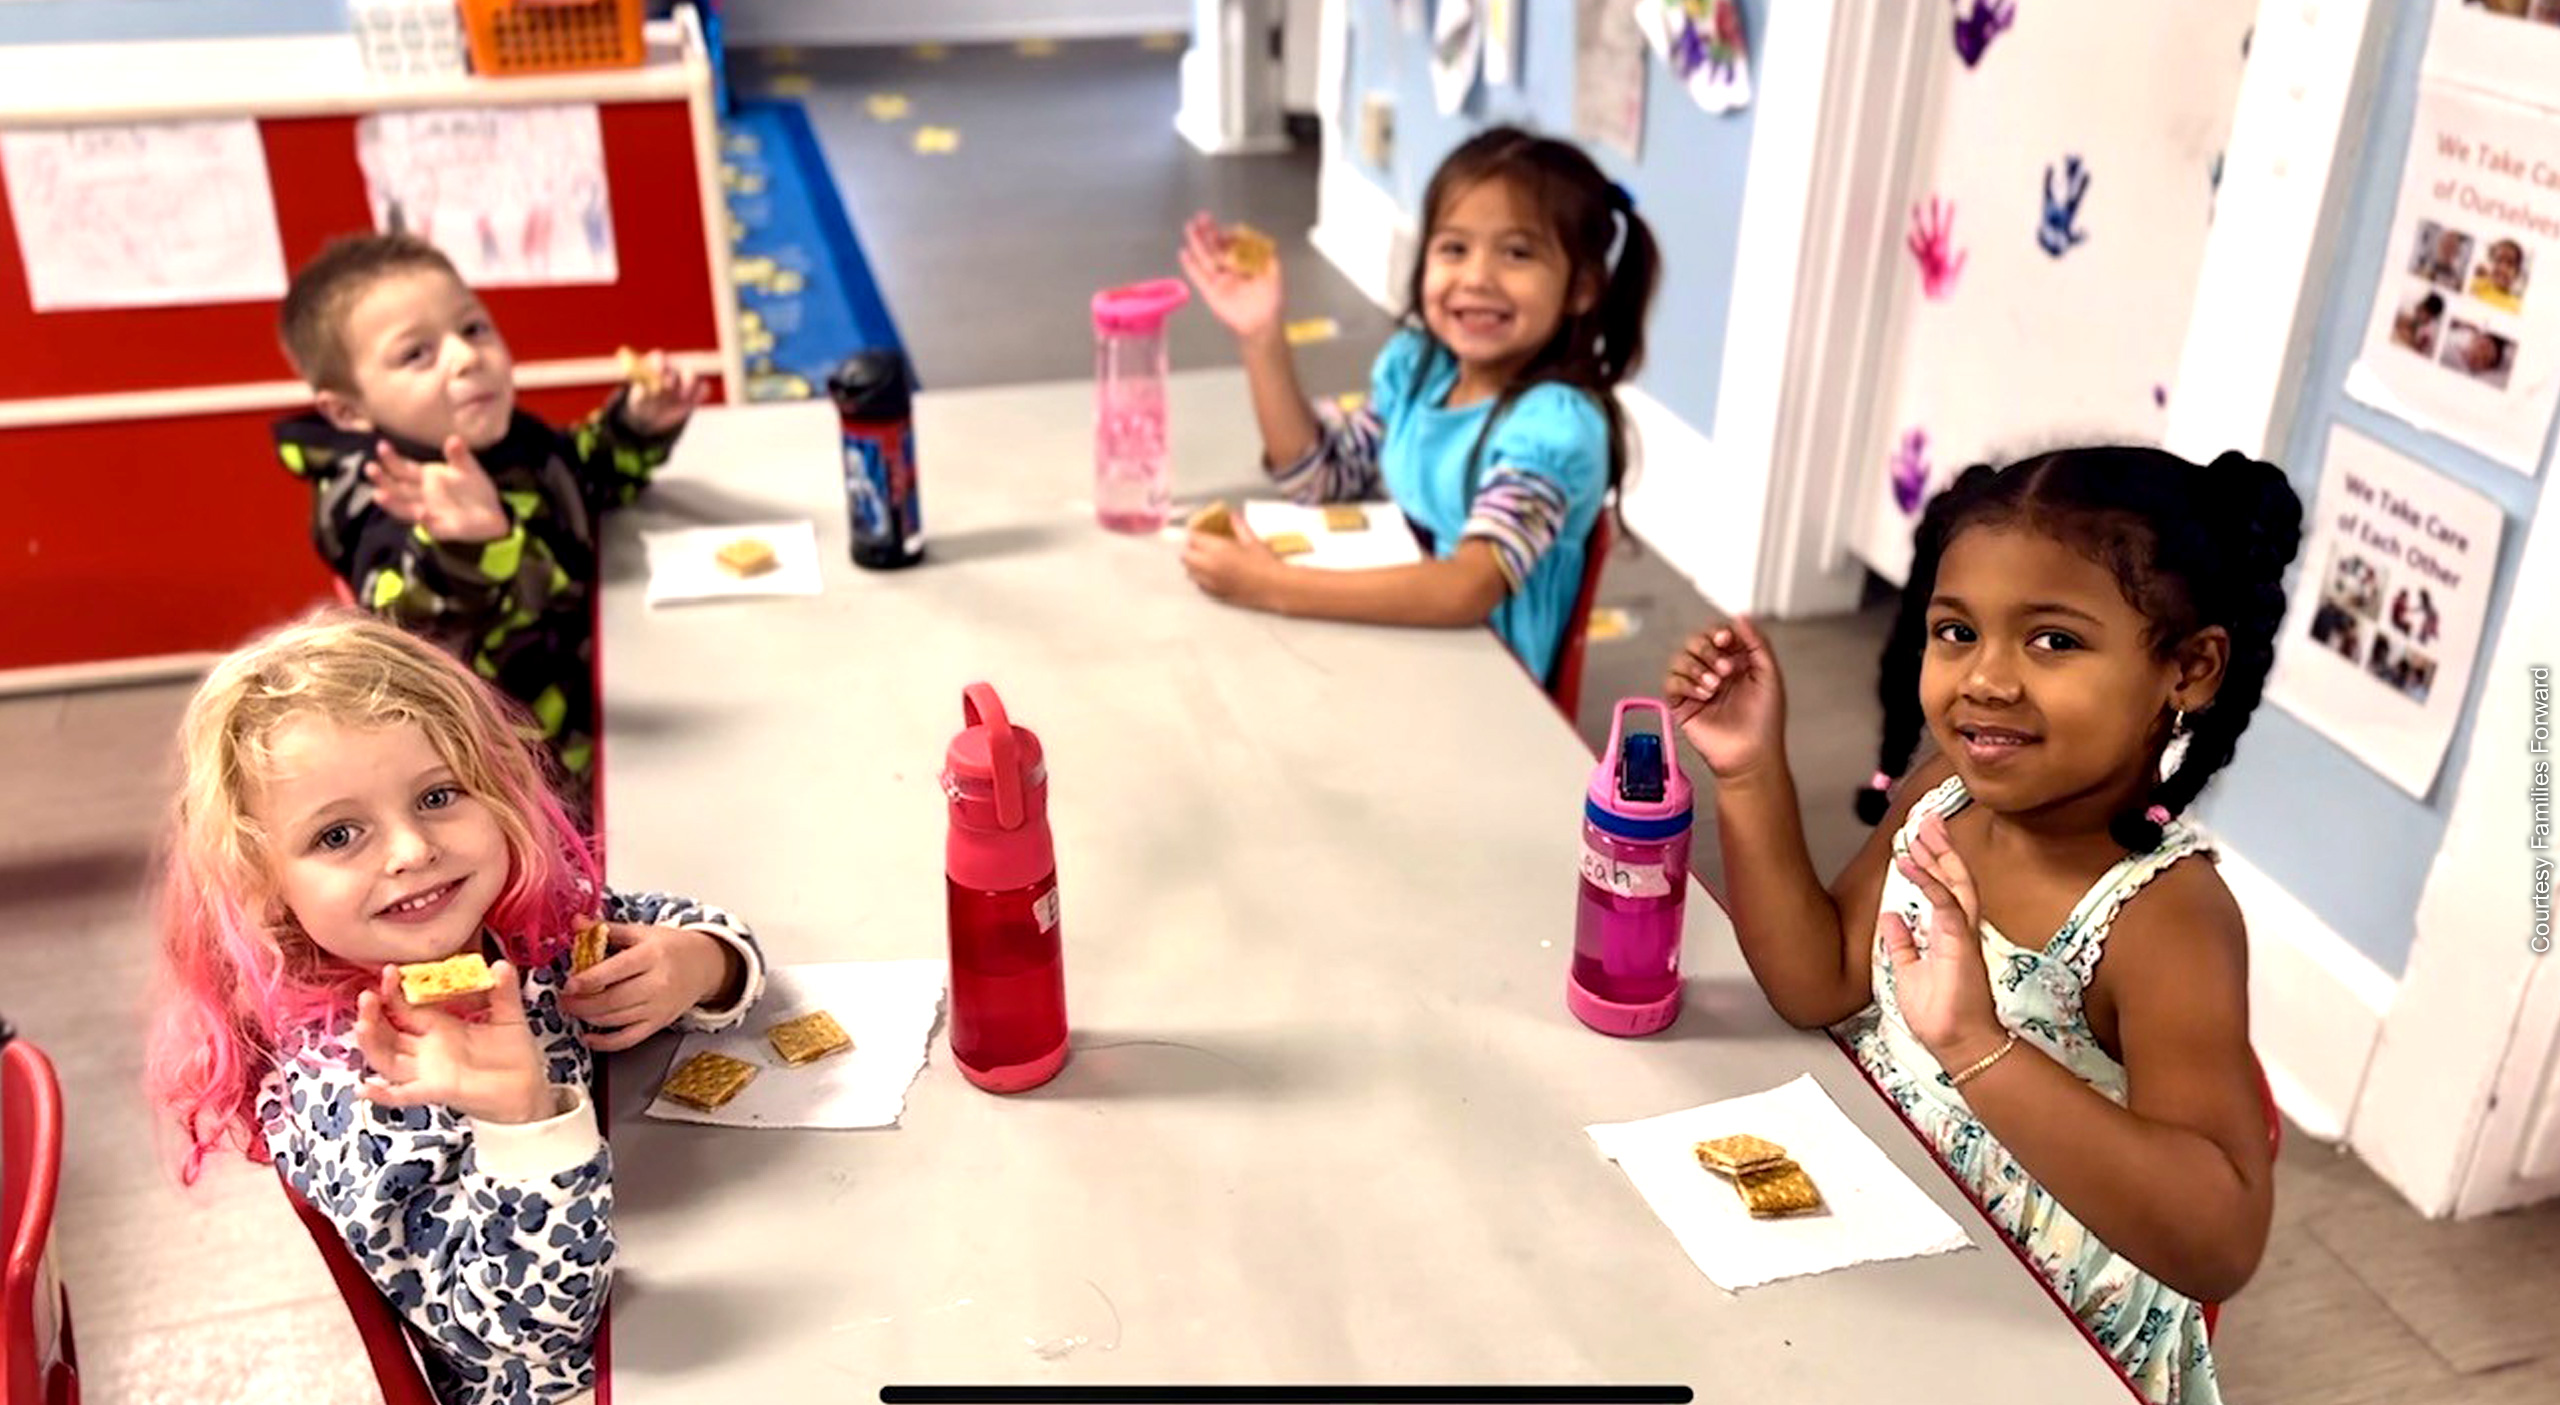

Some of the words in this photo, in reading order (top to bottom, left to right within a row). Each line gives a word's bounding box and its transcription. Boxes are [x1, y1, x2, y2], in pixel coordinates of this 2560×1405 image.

[2437, 132, 2470, 162] We
[2479, 143, 2525, 179] Take
[2530, 161, 2560, 190] Ca
[2433, 180, 2456, 201] of
[2459, 184, 2560, 239] Ourselves
[2344, 472, 2373, 503] We
[2381, 488, 2420, 528] Take
[2426, 514, 2469, 555] Care
[2337, 513, 2358, 535] of
[2360, 521, 2401, 559] Each
[2406, 546, 2461, 589] Other
